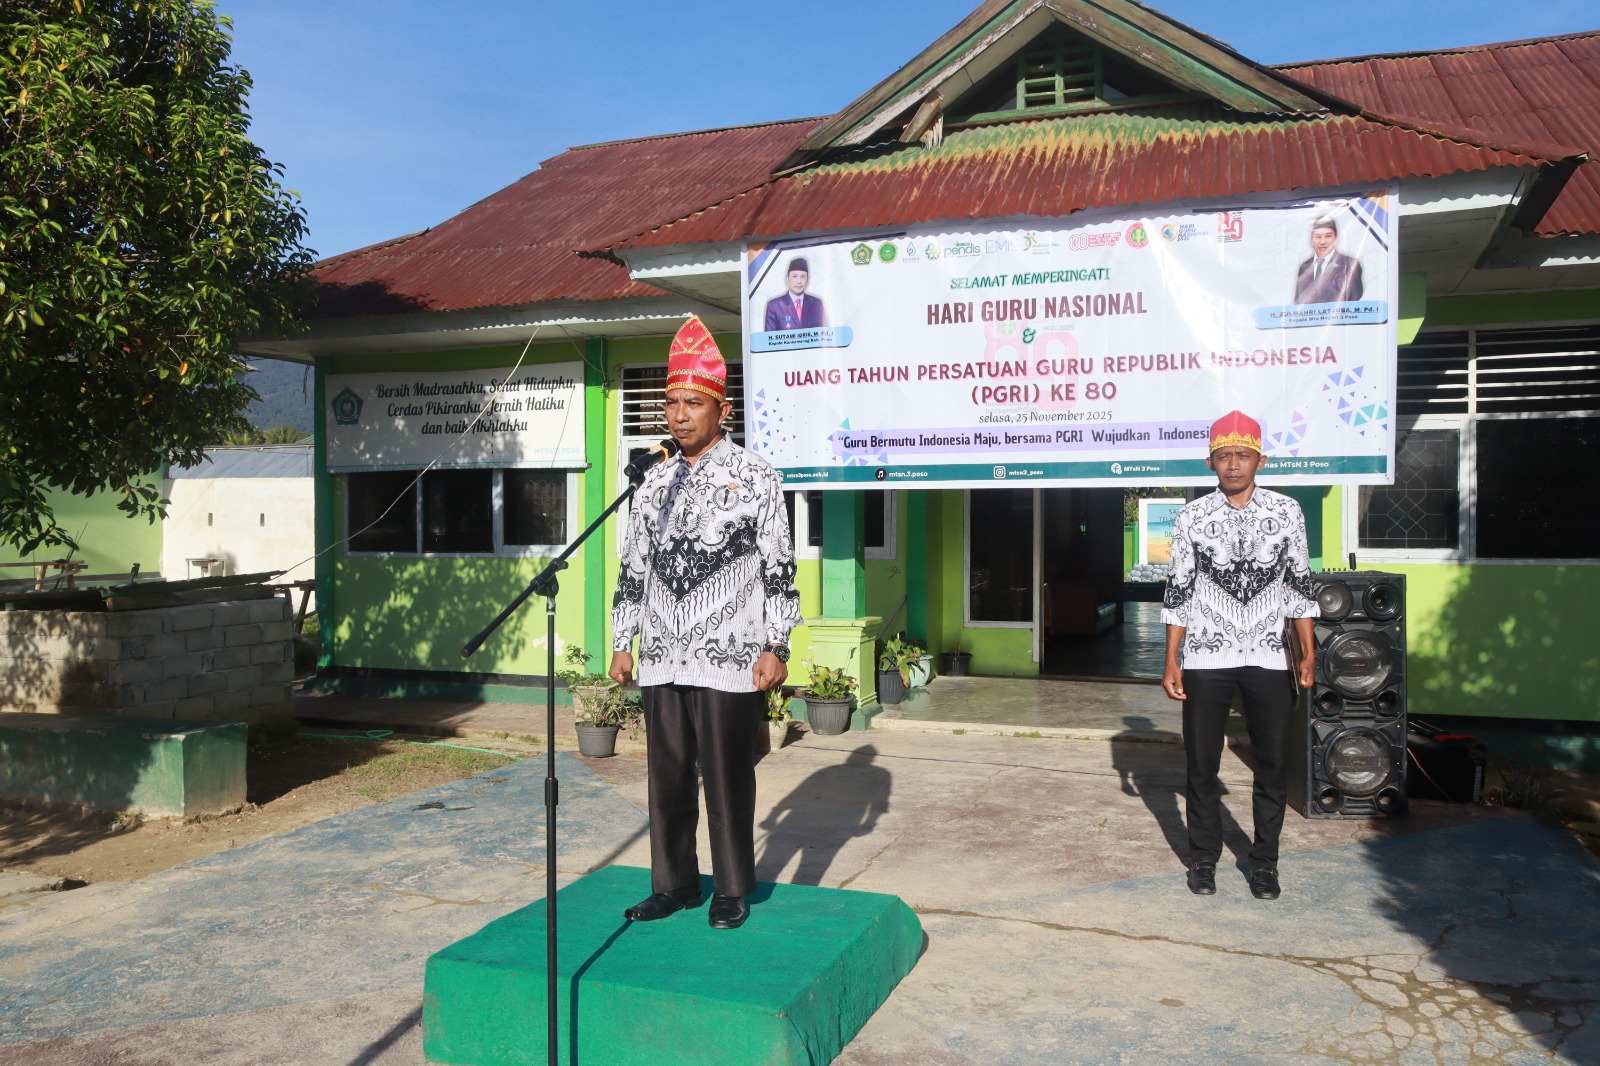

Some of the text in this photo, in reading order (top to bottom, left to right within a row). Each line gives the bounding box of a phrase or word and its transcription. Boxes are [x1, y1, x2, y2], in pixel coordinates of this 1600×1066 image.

[944, 244, 980, 258] pendis
[950, 267, 1111, 289] SELAMAT MEMPERINGATI
[927, 291, 1148, 326] HARI GURU NASIONAL
[1022, 327, 1037, 344] &
[784, 345, 1338, 388] ULANG TAHUN PERSATUAN GURU REPUBLIK INDONESIA
[376, 383, 410, 398] Bersih
[414, 381, 486, 397] Madrasahku,
[523, 376, 576, 394] Hidupku,
[971, 381, 1118, 405] (PGRI) KE 80
[387, 403, 423, 417] Cerdas
[486, 398, 523, 417] Jernih
[525, 396, 565, 411] Hatiku
[979, 410, 1113, 424] selasa, 25 November 2025
[421, 418, 528, 435] dan baik Akhlakku
[870, 435, 916, 448] Bermutu
[918, 433, 971, 446] Indonesia
[973, 432, 1002, 448] Maju,
[1004, 431, 1052, 445] bersama
[1056, 430, 1084, 443] PGRI
[1091, 428, 1151, 445] Wujudkan
[1158, 426, 1212, 440] Indonesi
